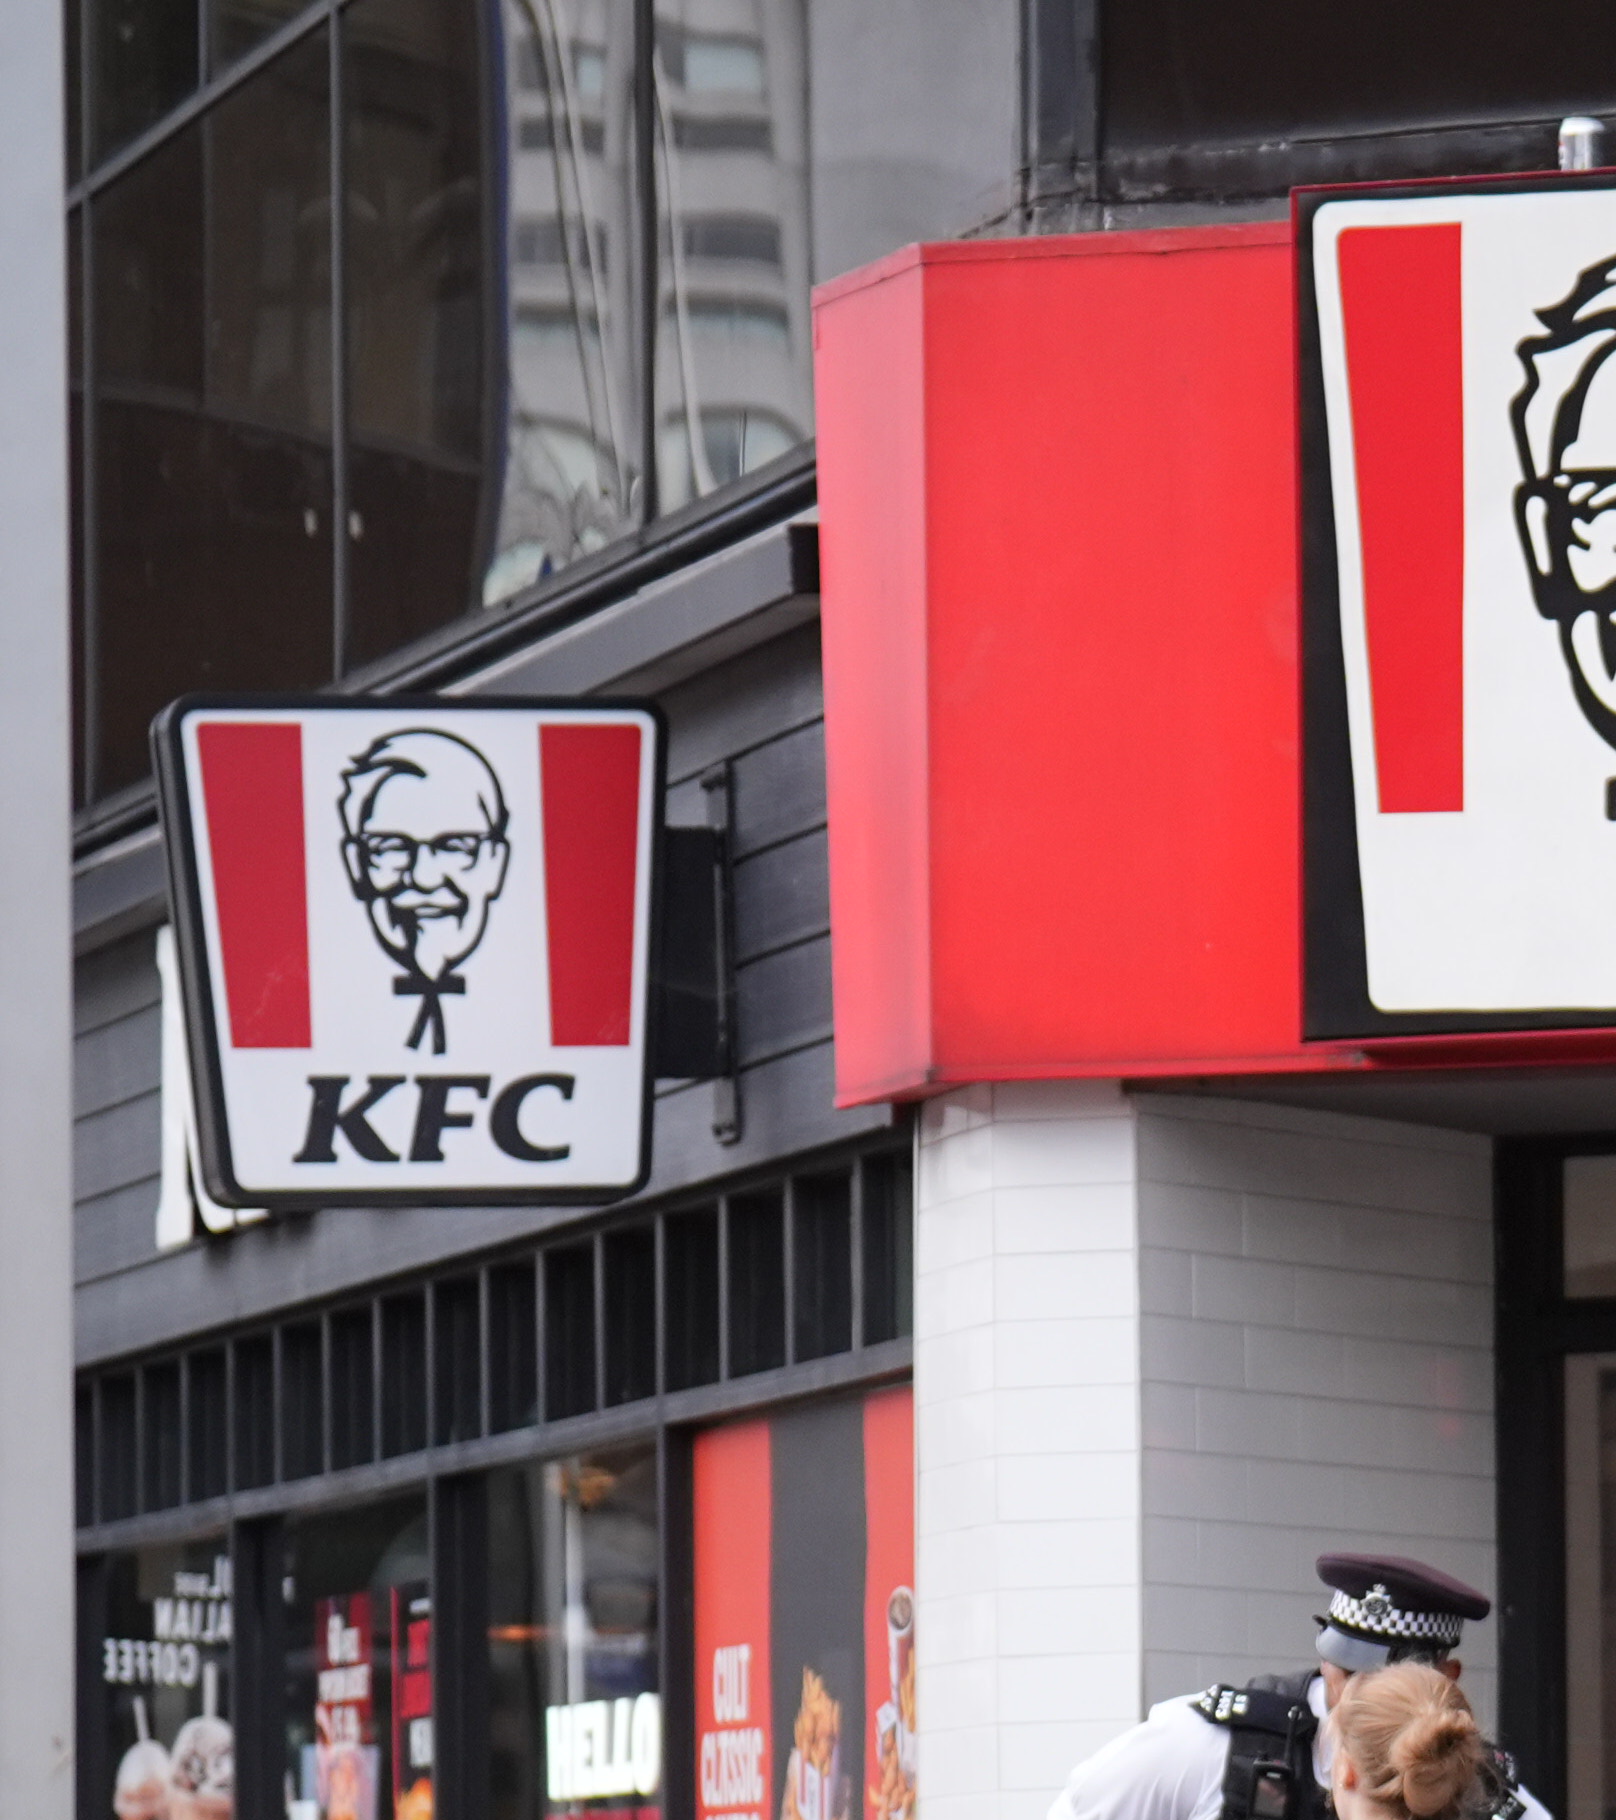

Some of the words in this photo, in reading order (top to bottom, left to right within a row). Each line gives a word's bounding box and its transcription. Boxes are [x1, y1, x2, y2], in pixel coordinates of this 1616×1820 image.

[292, 1072, 576, 1163] KFC
[713, 1644, 752, 1723] CULT
[545, 1692, 662, 1801] HELLO
[701, 1727, 765, 1808] CLASSIC
